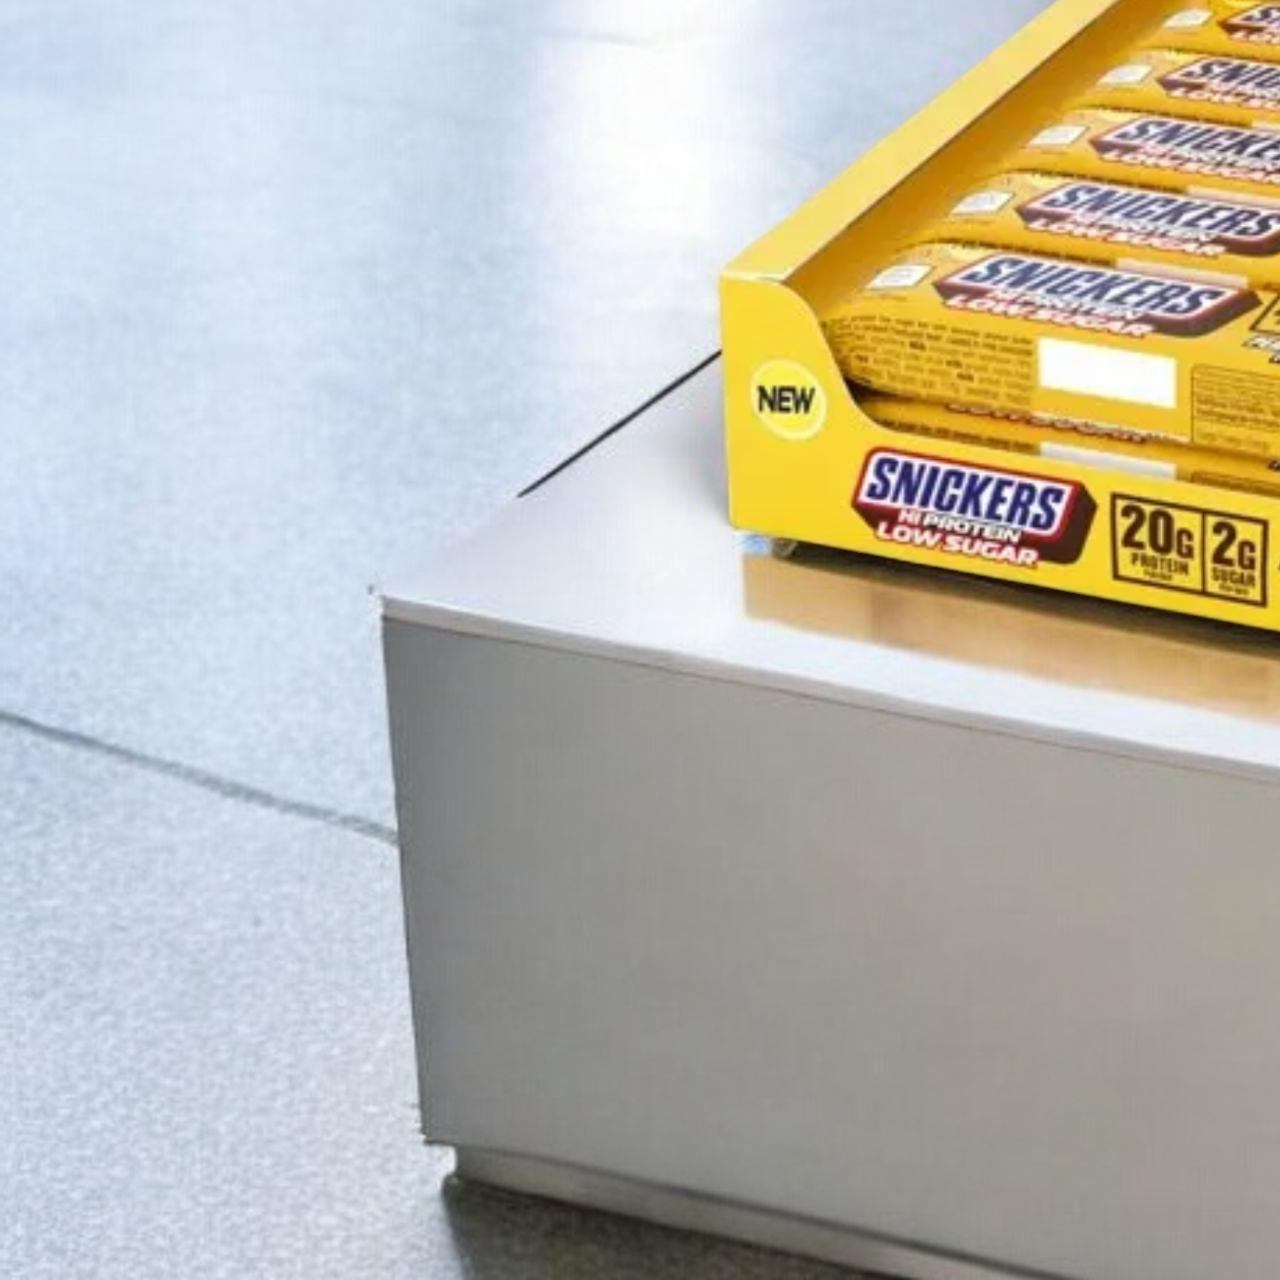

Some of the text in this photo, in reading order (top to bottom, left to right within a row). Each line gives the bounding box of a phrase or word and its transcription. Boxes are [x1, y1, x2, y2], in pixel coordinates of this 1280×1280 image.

[960, 257, 1226, 313] SNICKERS
[758, 385, 815, 414] NEW
[867, 457, 1065, 531] SNICKERS
[877, 521, 1040, 567] LOW SUGAR
[923, 512, 1023, 544] PROTEIN
[1121, 504, 1194, 559] 20G
[1212, 521, 1256, 570] 2G
